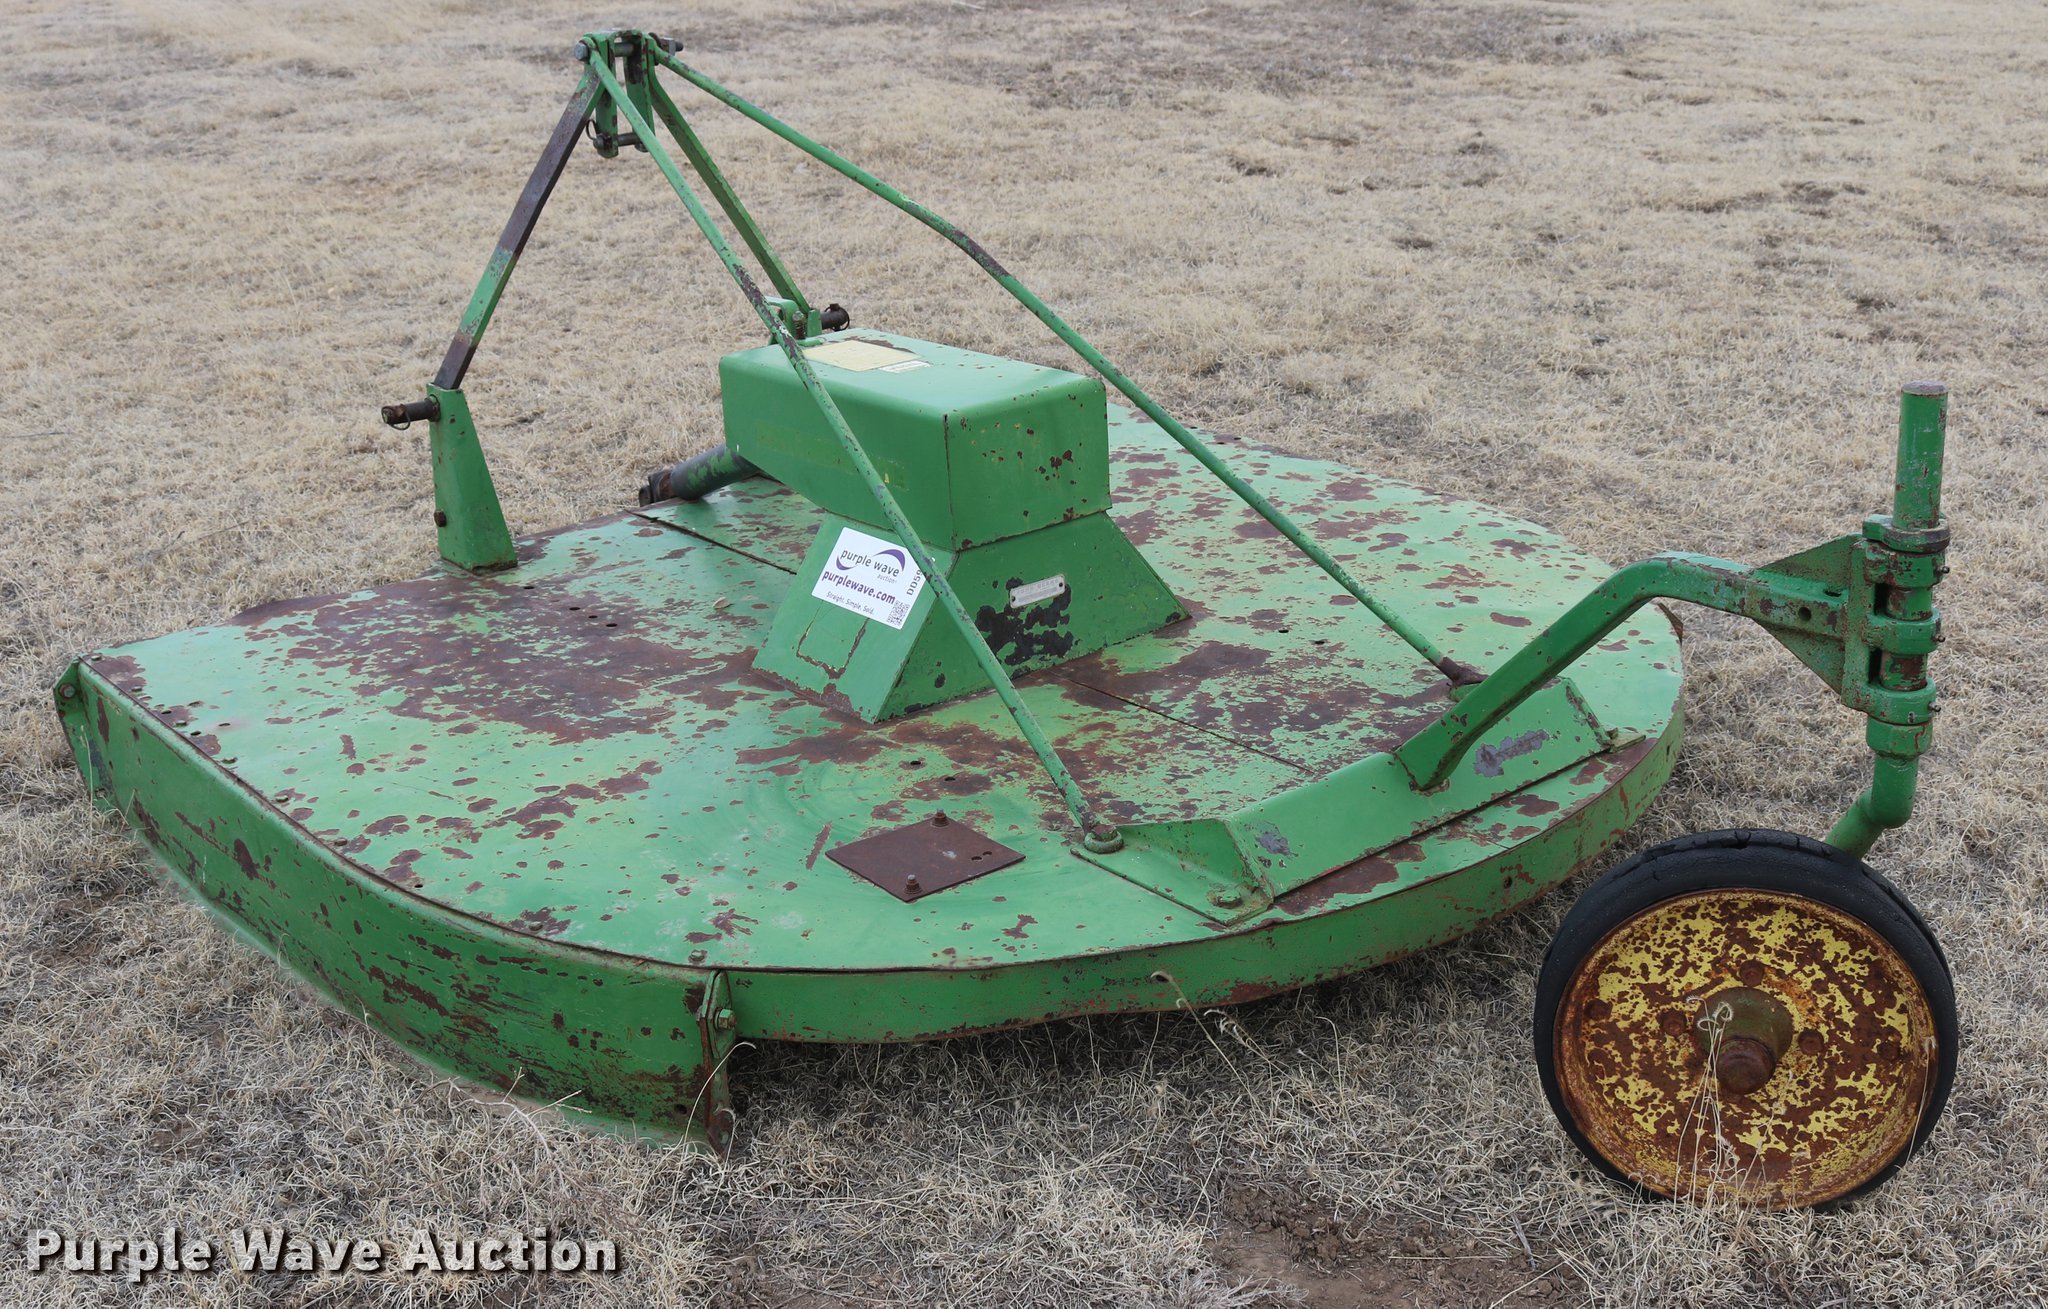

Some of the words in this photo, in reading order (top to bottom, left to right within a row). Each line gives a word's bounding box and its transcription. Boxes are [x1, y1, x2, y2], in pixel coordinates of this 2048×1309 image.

[840, 549, 872, 567] purple
[873, 561, 900, 578] wave
[821, 571, 896, 605] purplewave.com
